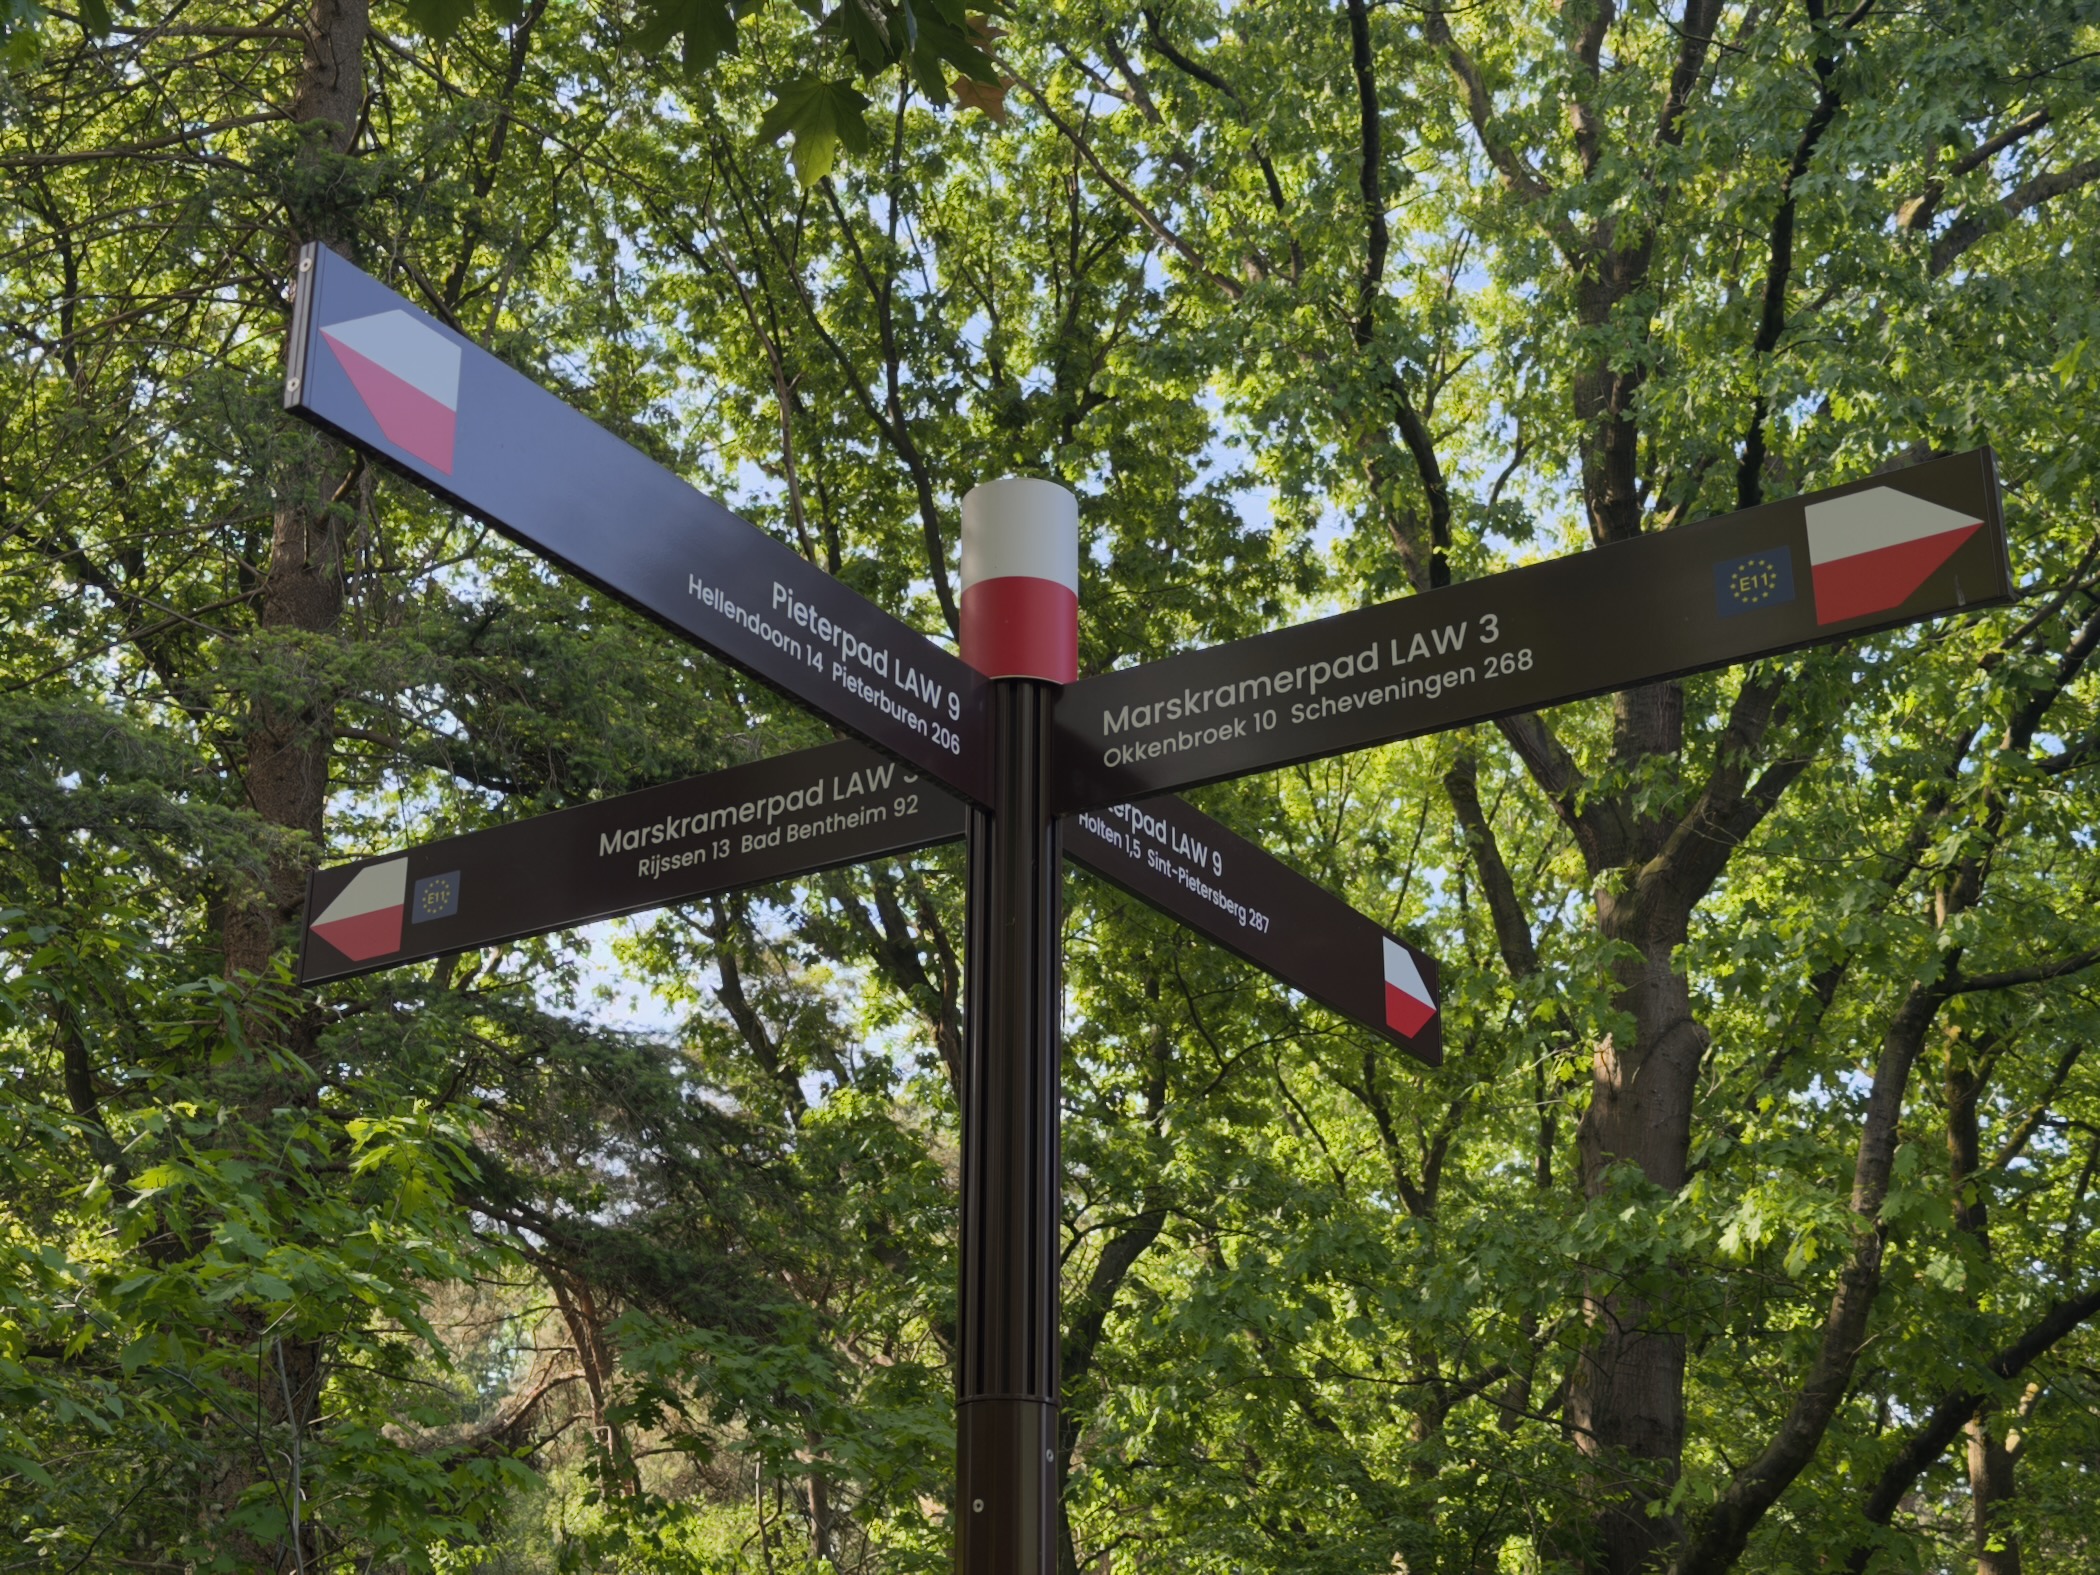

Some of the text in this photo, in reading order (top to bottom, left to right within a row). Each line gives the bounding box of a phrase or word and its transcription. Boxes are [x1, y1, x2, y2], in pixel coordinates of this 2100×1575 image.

[1740, 573, 1769, 592] E11
[689, 574, 960, 755] Hellendoorn 14 Pieterburen 206
[773, 582, 960, 720] Pieterpad LAW 9
[1104, 614, 1499, 735] Marskramerpad LAW 3
[1104, 649, 1533, 767] Okkenbroek 10 Scheveningen 268
[600, 763, 895, 856] Marskramerpad LAW
[639, 795, 918, 879] Rijssen 13 Bad Bentheim 92
[1108, 803, 1222, 876] erpad LAW 9
[1079, 812, 1269, 933] Holten 1,5 Sint-Pietersberg 287
